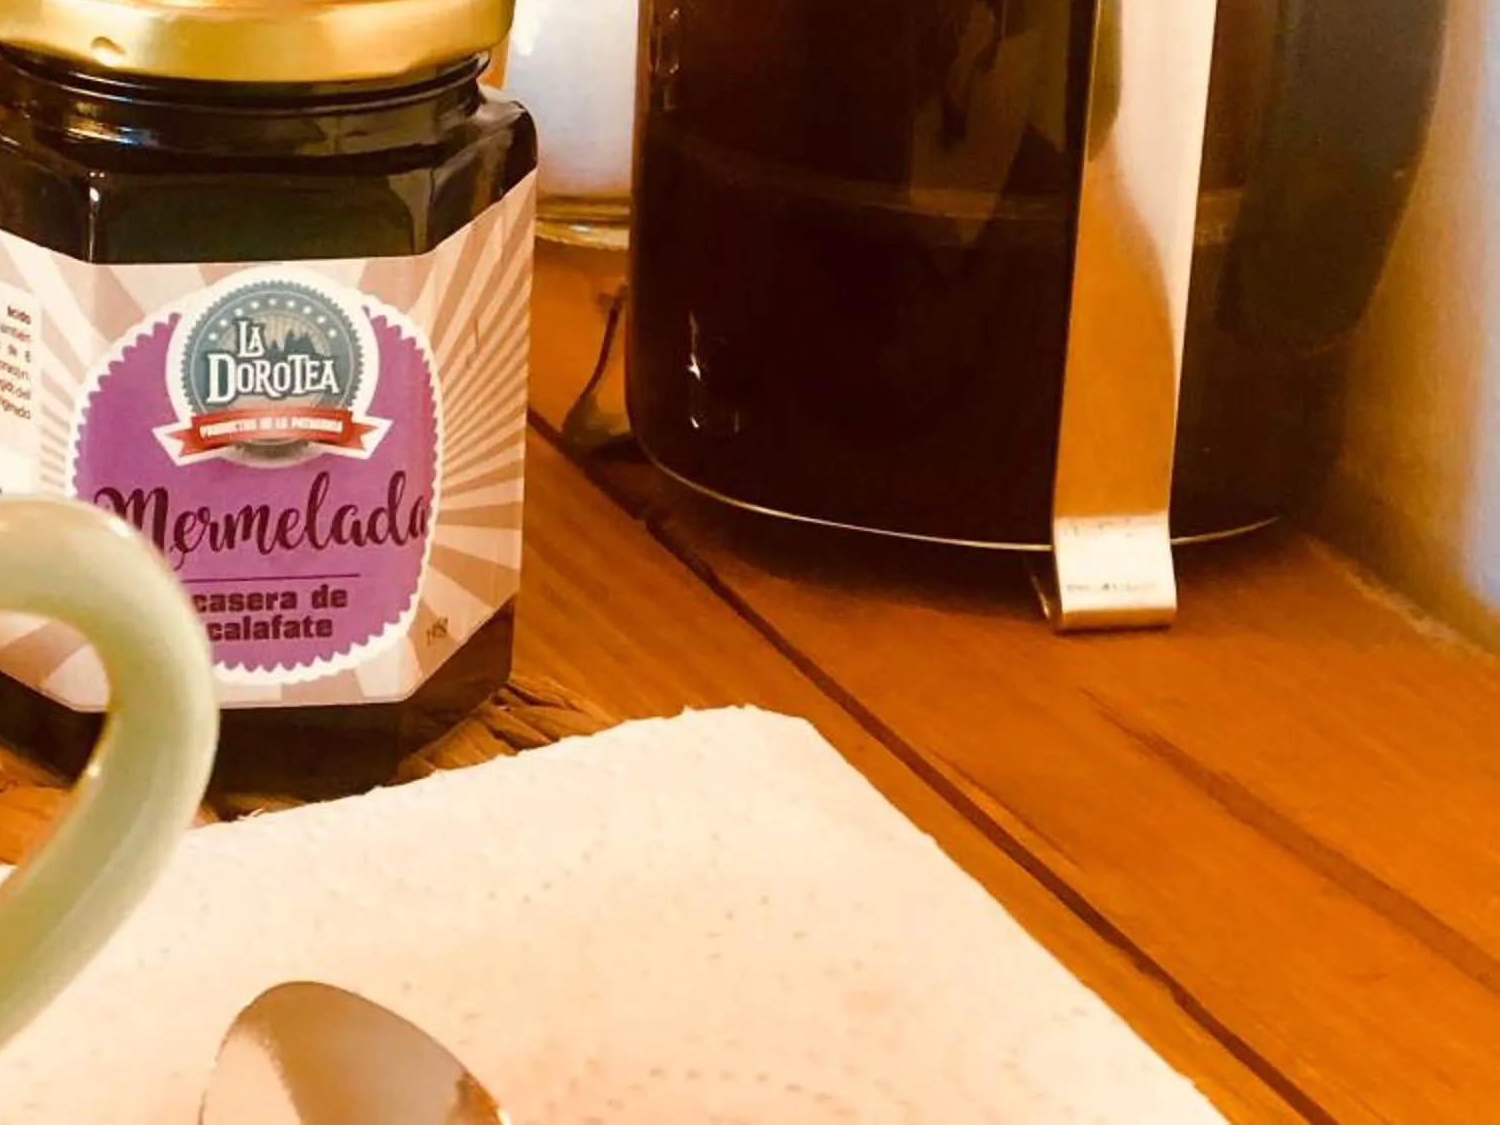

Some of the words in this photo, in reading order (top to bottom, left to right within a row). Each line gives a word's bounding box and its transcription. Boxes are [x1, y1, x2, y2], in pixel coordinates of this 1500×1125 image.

[237, 320, 265, 358] LA
[206, 353, 340, 404] DOROTEA
[94, 470, 428, 572] Mermelada
[192, 585, 298, 613] casera
[311, 584, 348, 610] de
[207, 615, 333, 642] calafate
